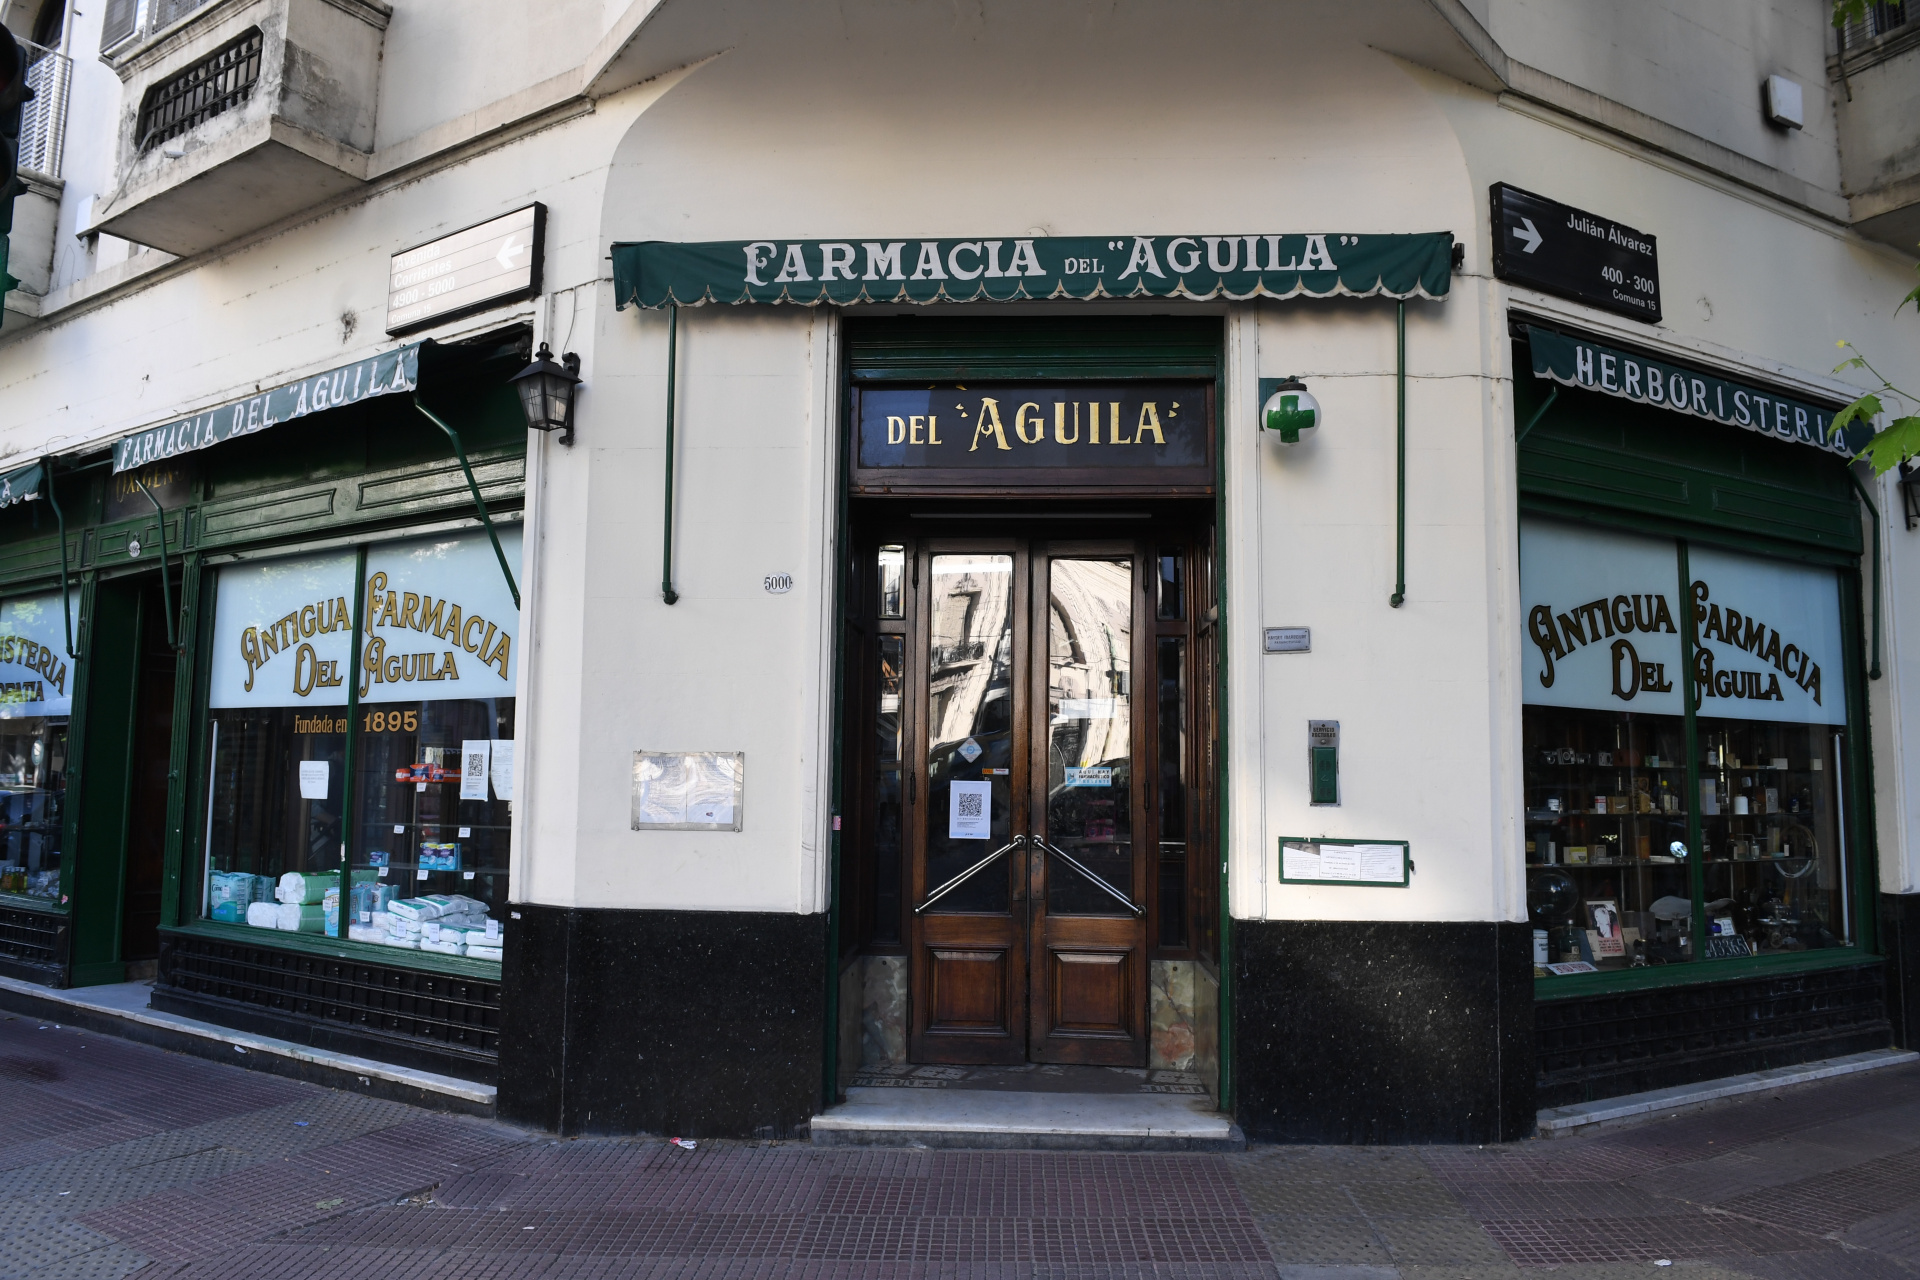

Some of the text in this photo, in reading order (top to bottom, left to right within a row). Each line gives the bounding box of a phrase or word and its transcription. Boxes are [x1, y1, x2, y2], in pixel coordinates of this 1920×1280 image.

[1567, 213, 1652, 256] Julián Álvarez
[395, 244, 440, 270] Avenida
[743, 240, 1047, 286] FARMACIA
[1064, 257, 1105, 274] DEL
[394, 260, 452, 288] Corrientes
[1602, 266, 1623, 284] 400
[1633, 276, 1655, 294] 300
[392, 288, 419, 308] 4900
[428, 276, 455, 297] 5000
[1613, 289, 1656, 310] Comuna 15
[391, 304, 431, 324] Comuna 15
[1575, 345, 1847, 450] HERBORISTERIA
[120, 413, 214, 470] FARMACIA
[232, 394, 273, 433] DEL
[886, 415, 942, 444] DEL
[764, 576, 792, 590] 5000
[240, 571, 511, 692] ANTIGUA FARMACIA
[1528, 580, 1822, 707] ANTIGUA FARMACIA
[293, 637, 459, 697] DEL AGUILA
[1611, 638, 1784, 711] DEL AGUILA
[294, 710, 418, 734] Fundada en 1895
